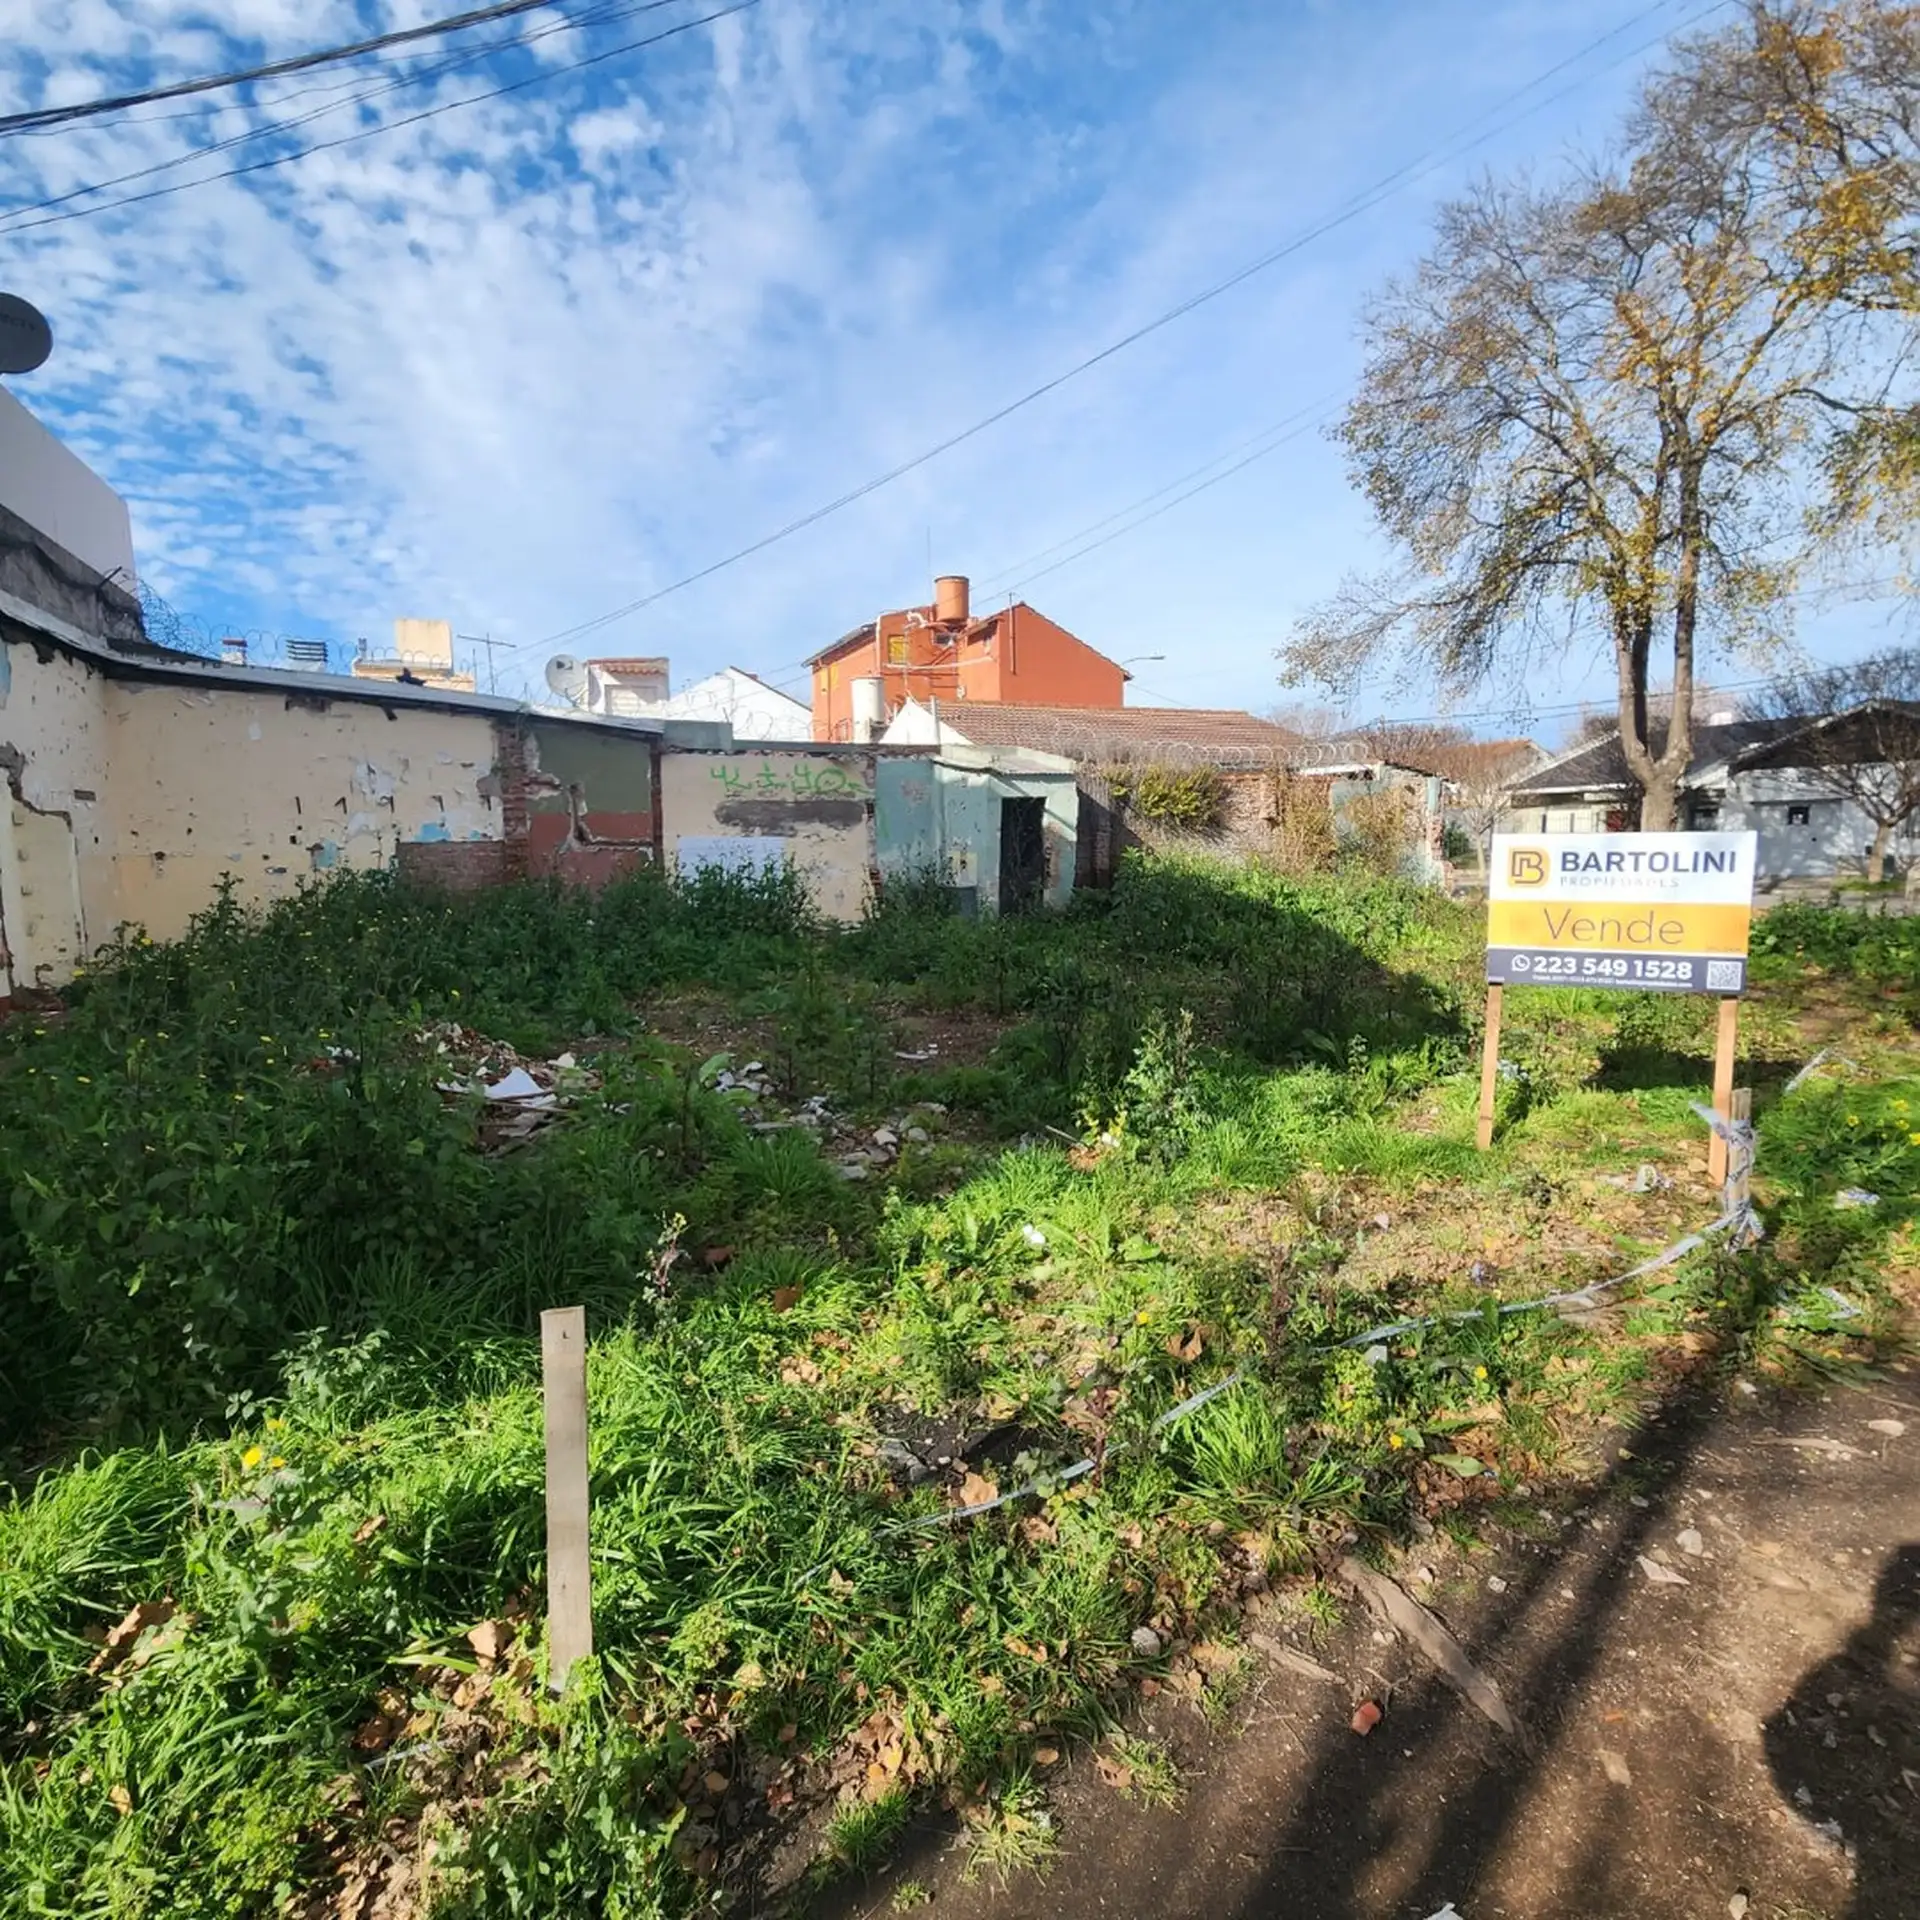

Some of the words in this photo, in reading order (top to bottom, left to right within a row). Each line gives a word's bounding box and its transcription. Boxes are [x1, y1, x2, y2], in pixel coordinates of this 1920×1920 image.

[1560, 851, 1736, 873] BARTOLINI
[1543, 907, 1684, 945] Vende
[1533, 956, 1577, 975] 223
[1582, 957, 1628, 978] 549
[1633, 959, 1693, 980] 1528
